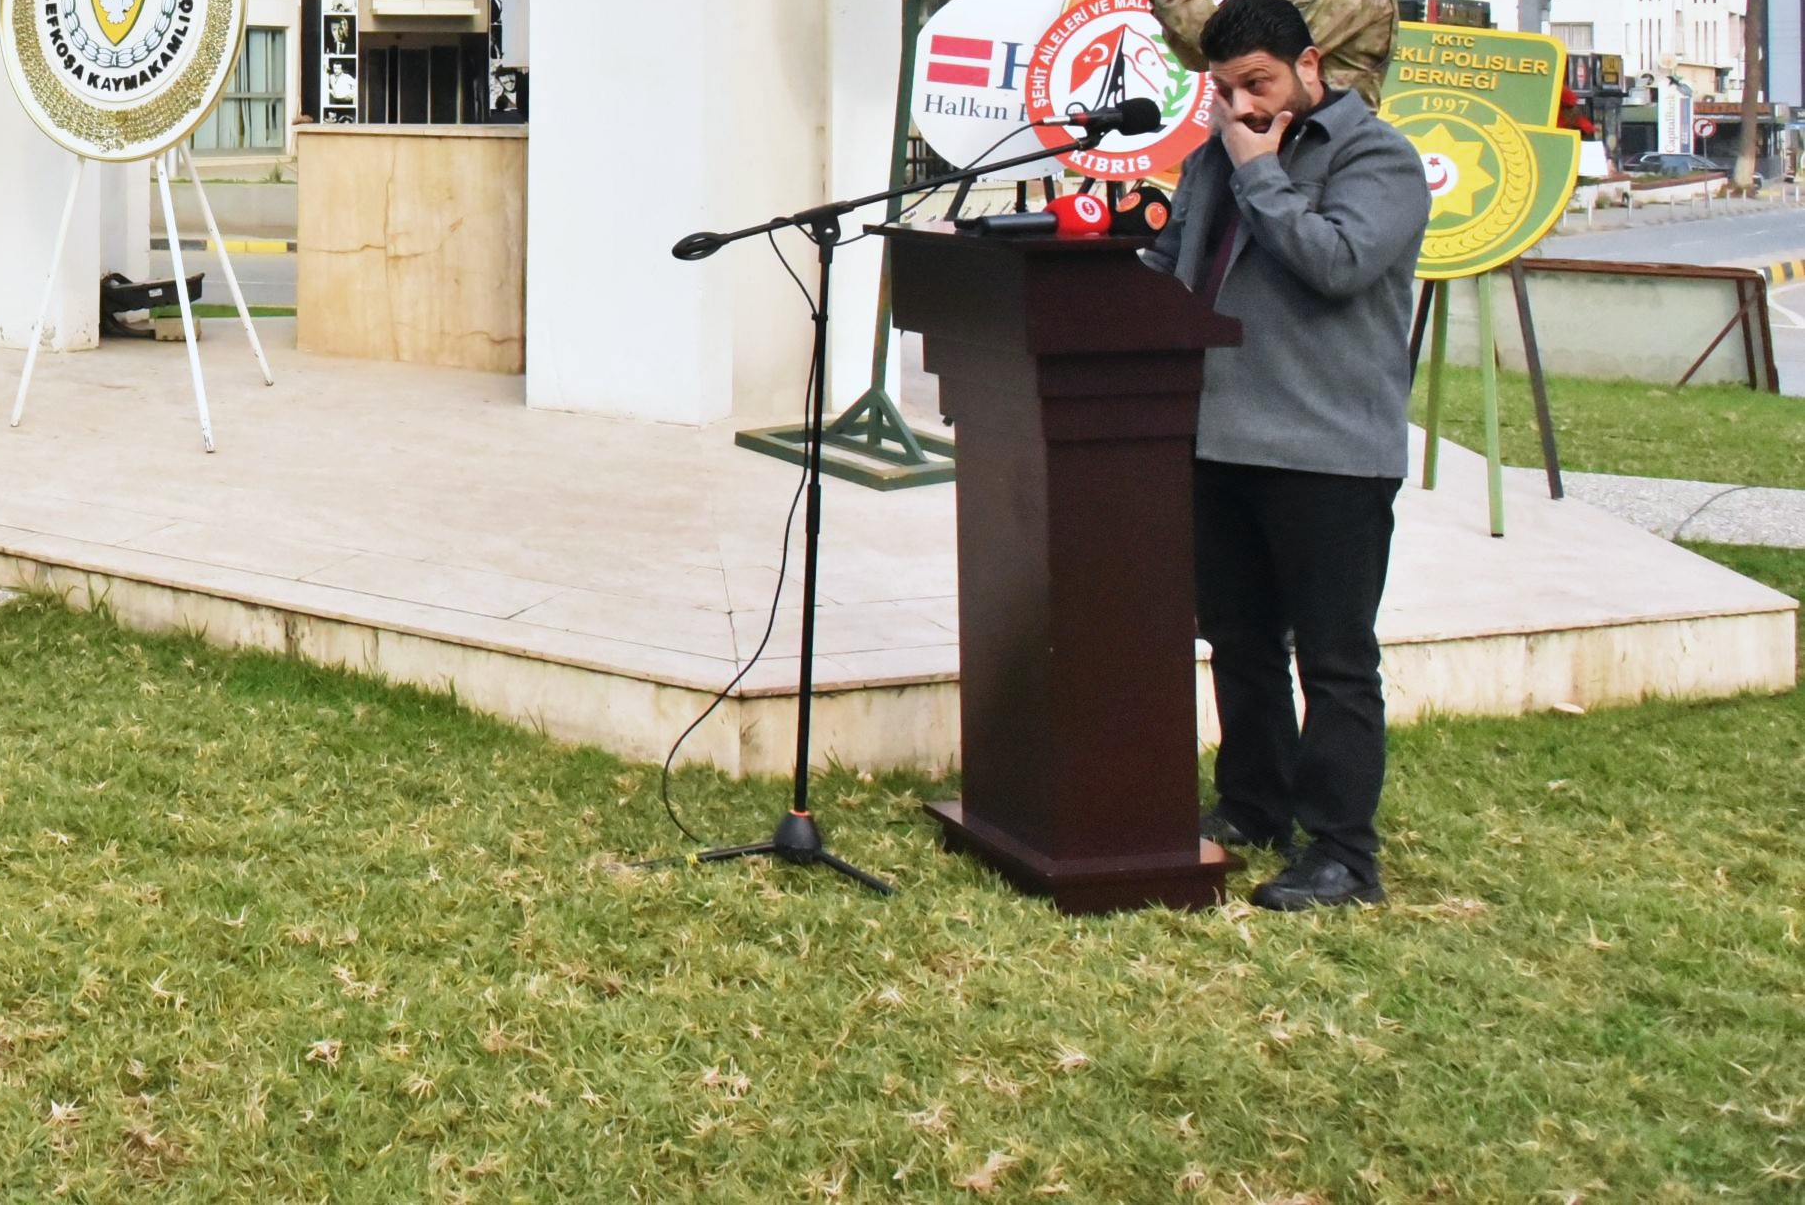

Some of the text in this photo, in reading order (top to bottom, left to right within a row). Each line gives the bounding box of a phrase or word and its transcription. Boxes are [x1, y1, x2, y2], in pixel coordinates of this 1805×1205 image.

[1038, 6, 1089, 66] AİLELERİ
[1432, 33, 1476, 48] KKTC
[1030, 66, 1049, 109] ŞEHİT
[1398, 66, 1499, 91] DERNEĞİ
[923, 93, 1009, 121] Halkın
[1421, 96, 1470, 115] 1997
[1068, 149, 1152, 174] KIBRIS
